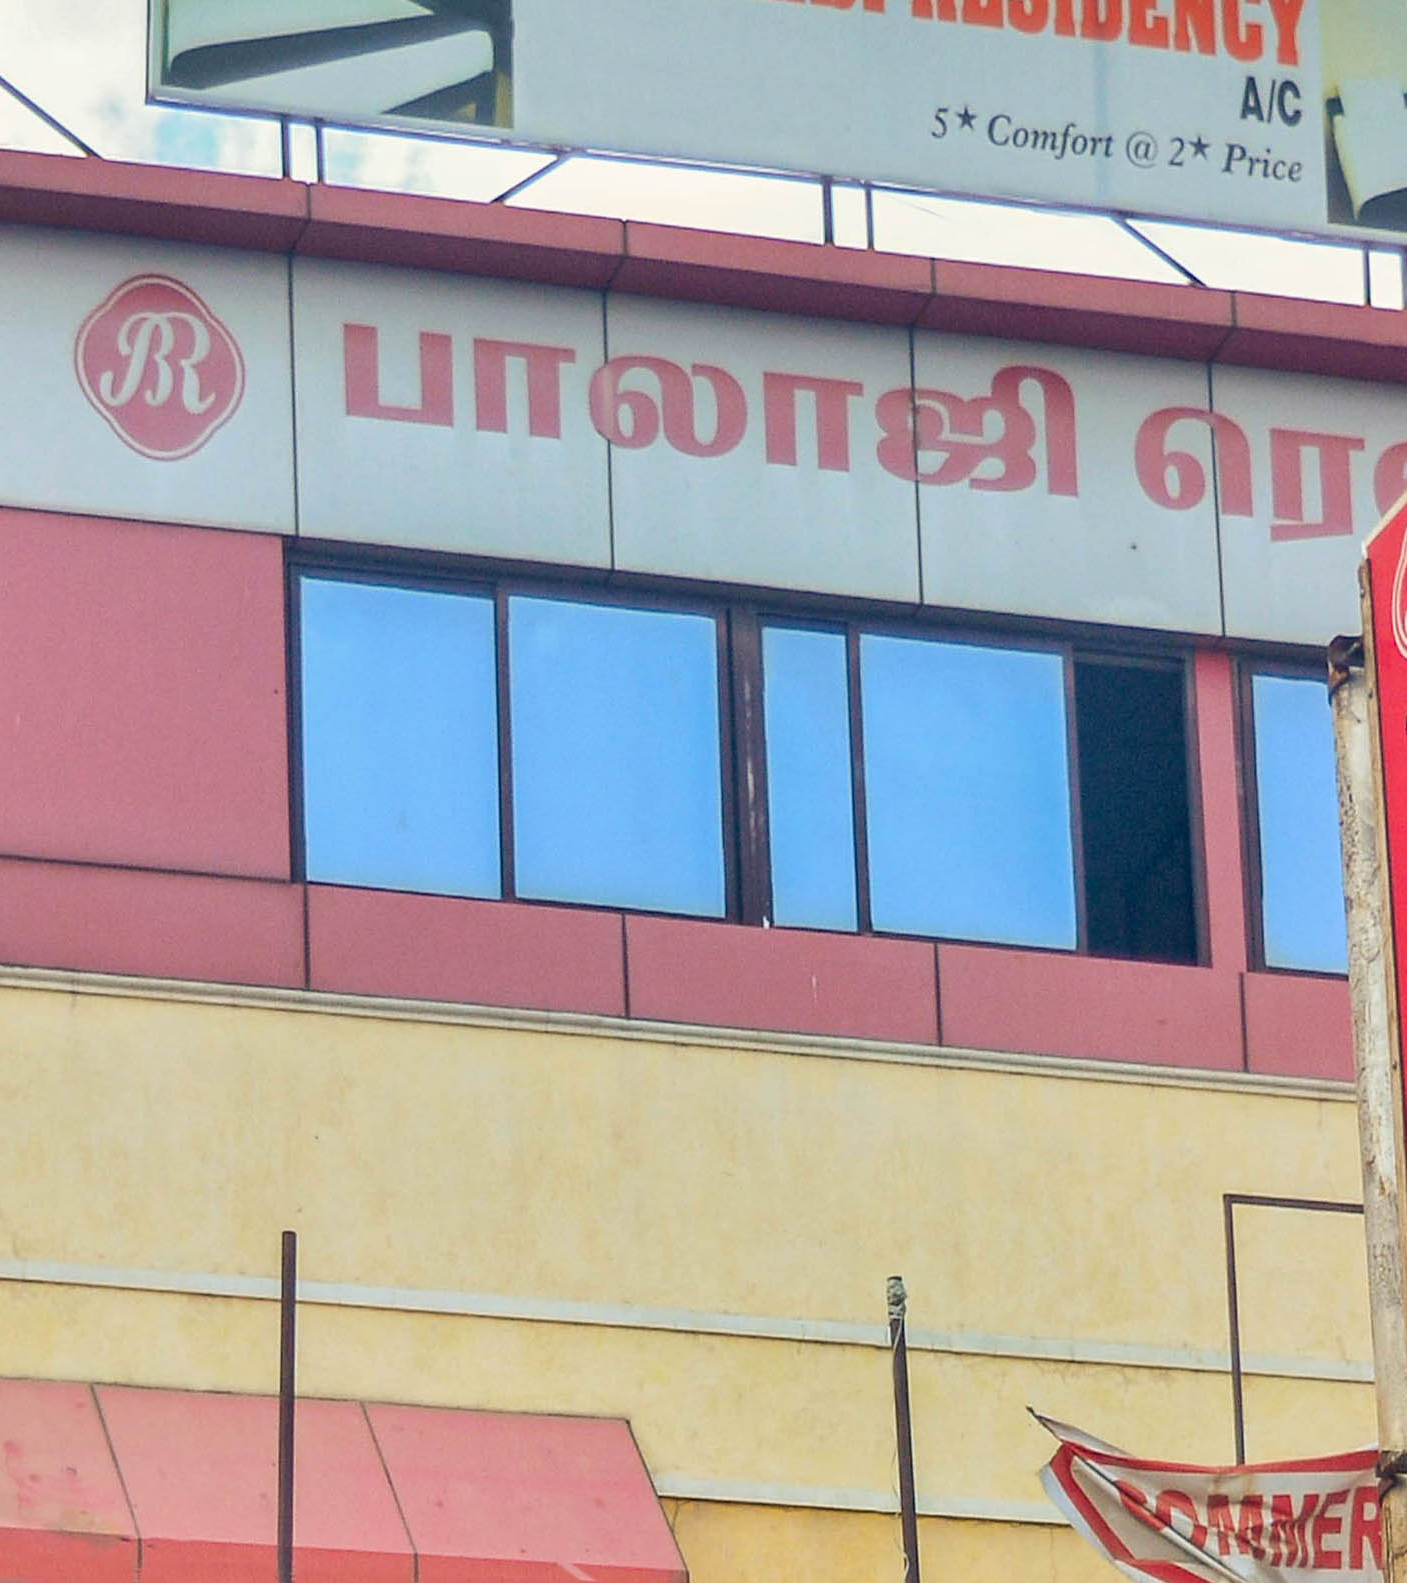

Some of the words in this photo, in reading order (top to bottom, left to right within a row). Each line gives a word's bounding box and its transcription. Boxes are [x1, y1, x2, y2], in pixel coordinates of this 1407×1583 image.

[1240, 76, 1302, 127] A/C
[987, 112, 1115, 161] Comfort
[1125, 130, 1159, 168] @
[1223, 142, 1303, 183] Price
[343, 322, 1079, 498] பாலாஜி
